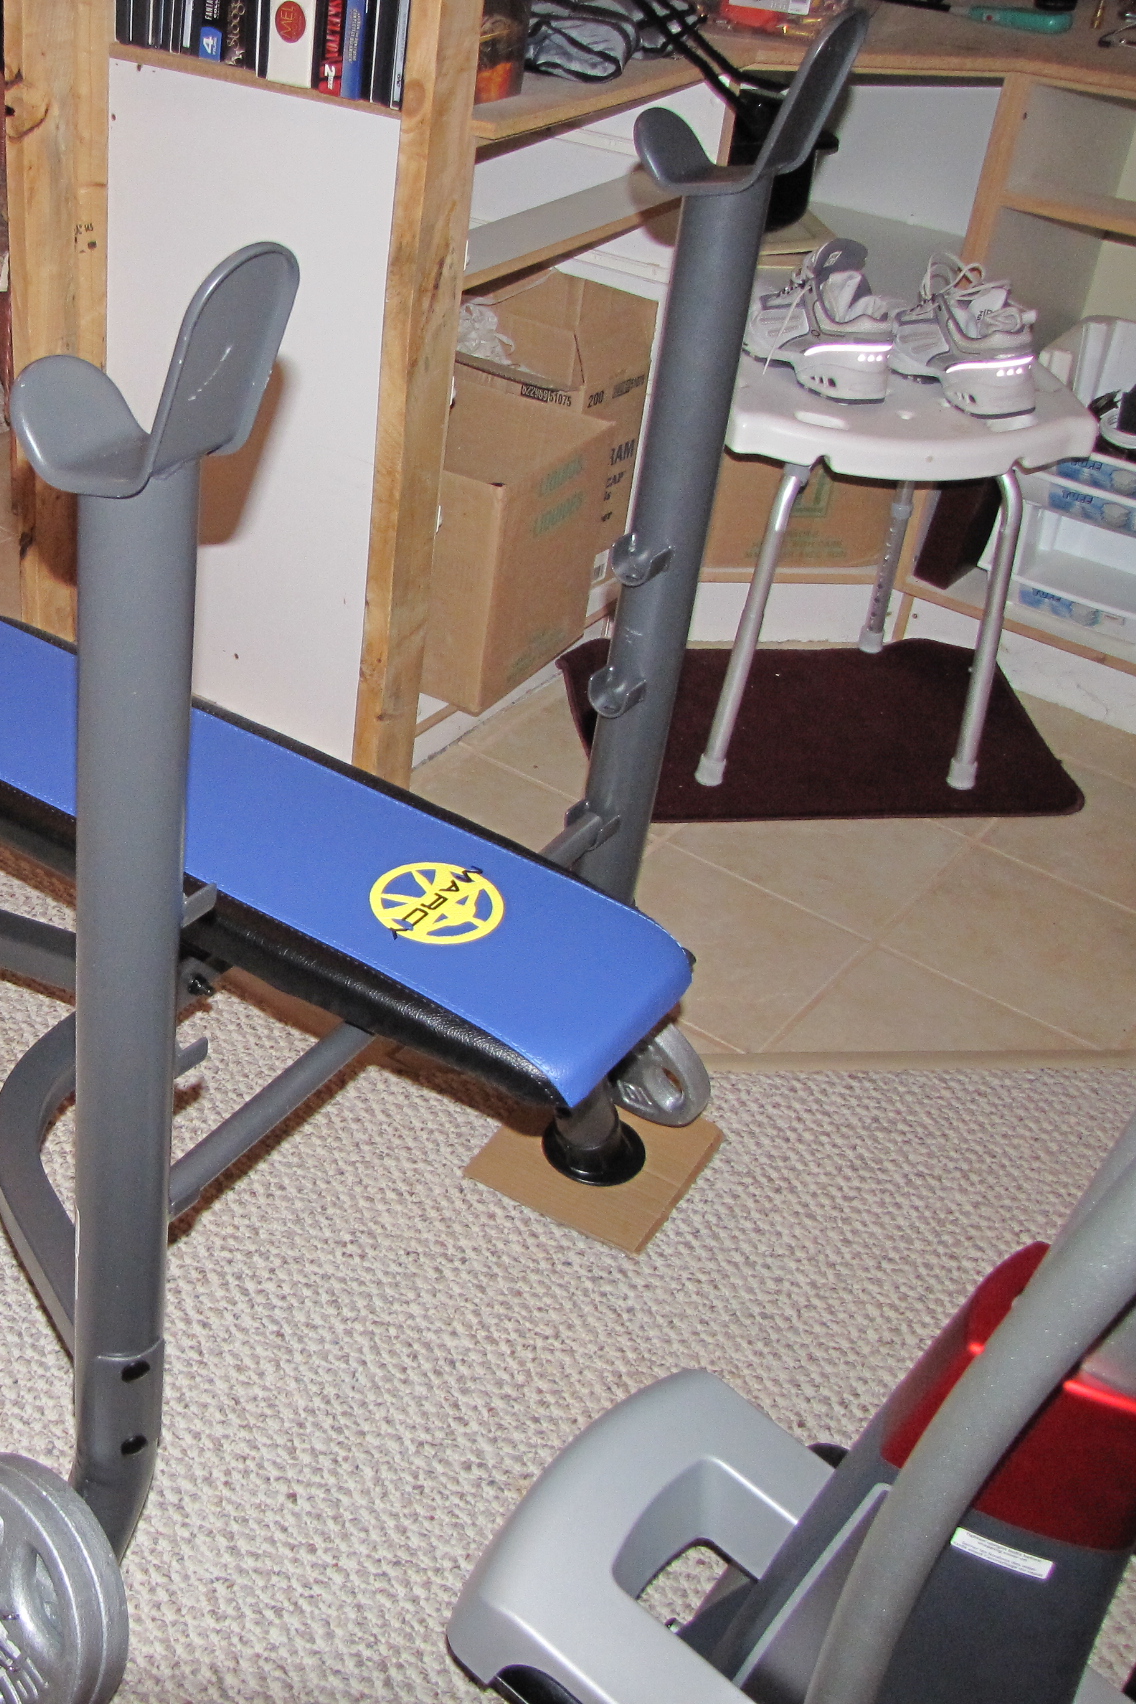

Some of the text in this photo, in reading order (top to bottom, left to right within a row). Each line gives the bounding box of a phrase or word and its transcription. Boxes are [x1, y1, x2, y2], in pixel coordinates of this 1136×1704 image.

[280, 7, 294, 38] MEL
[203, 36, 214, 54] 4
[325, 64, 335, 77] 2
[587, 390, 604, 408] 200
